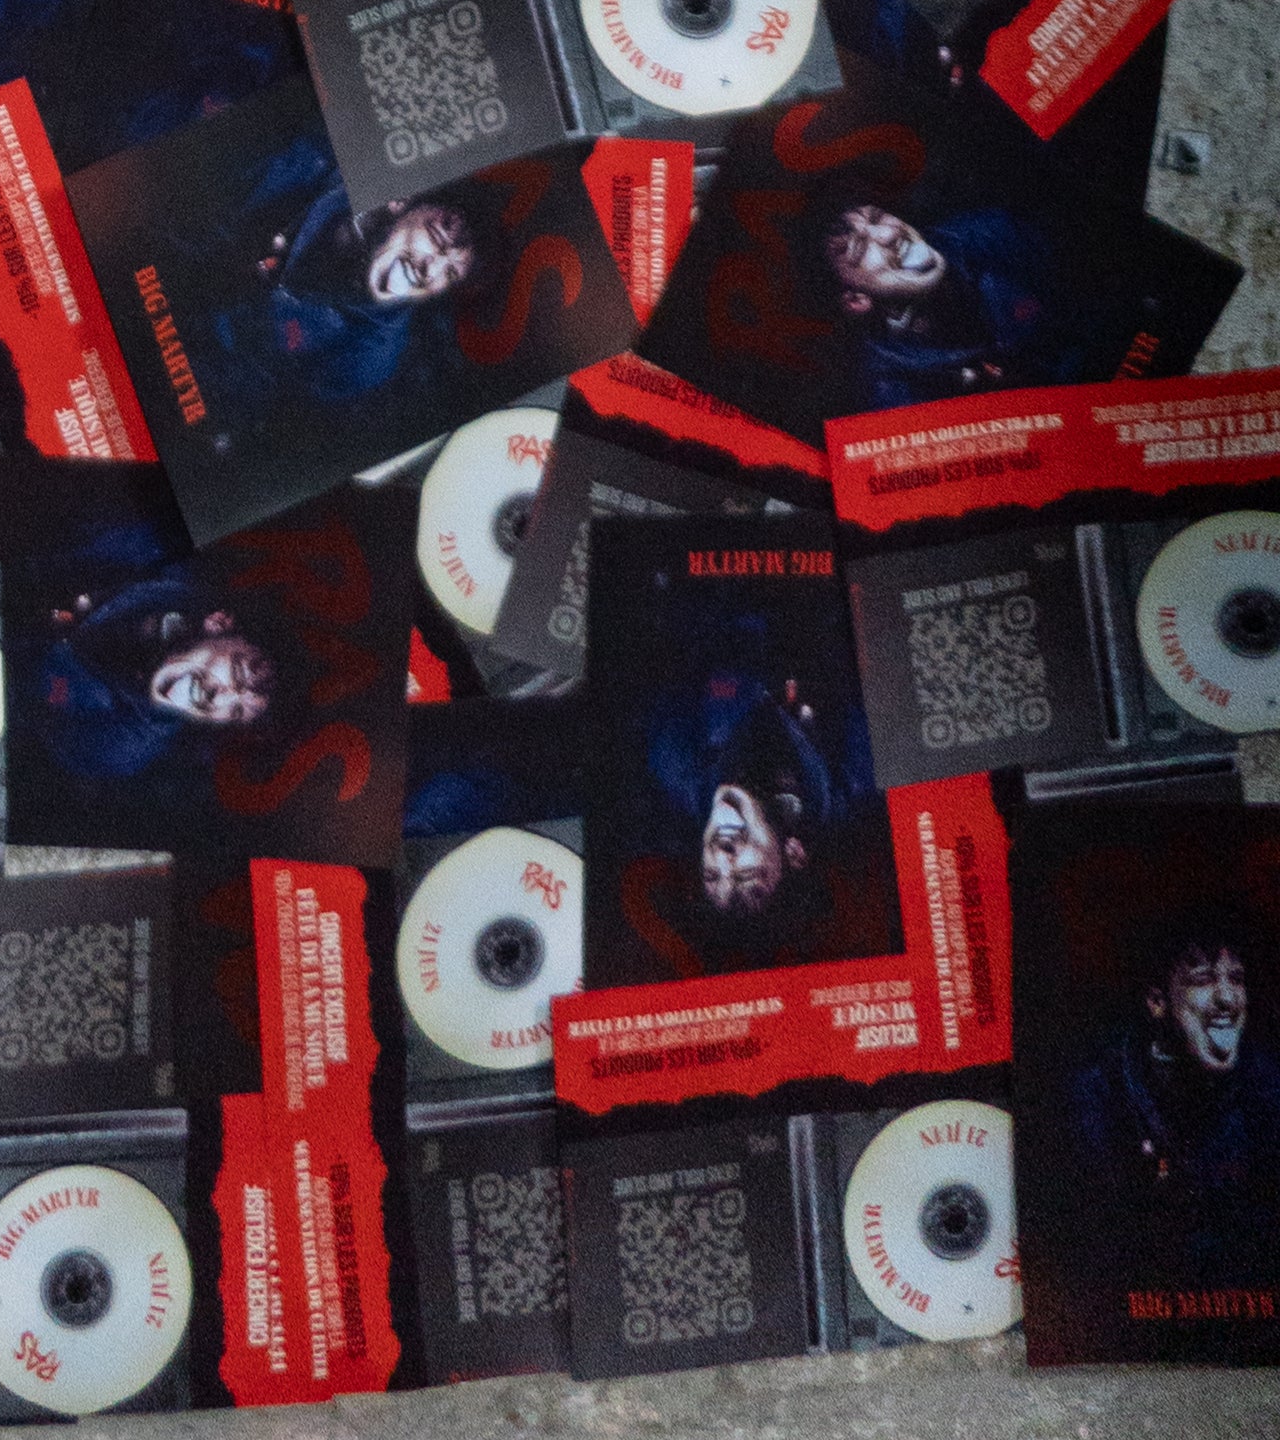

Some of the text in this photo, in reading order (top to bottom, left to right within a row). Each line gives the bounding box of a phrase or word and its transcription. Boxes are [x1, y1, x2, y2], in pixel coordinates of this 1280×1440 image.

[131, 264, 210, 424] BIG MARTYR
[20, 1187, 102, 1234] MARTYR
[144, 1251, 174, 1331] 21 JUIN
[12, 1330, 62, 1385] RAS
